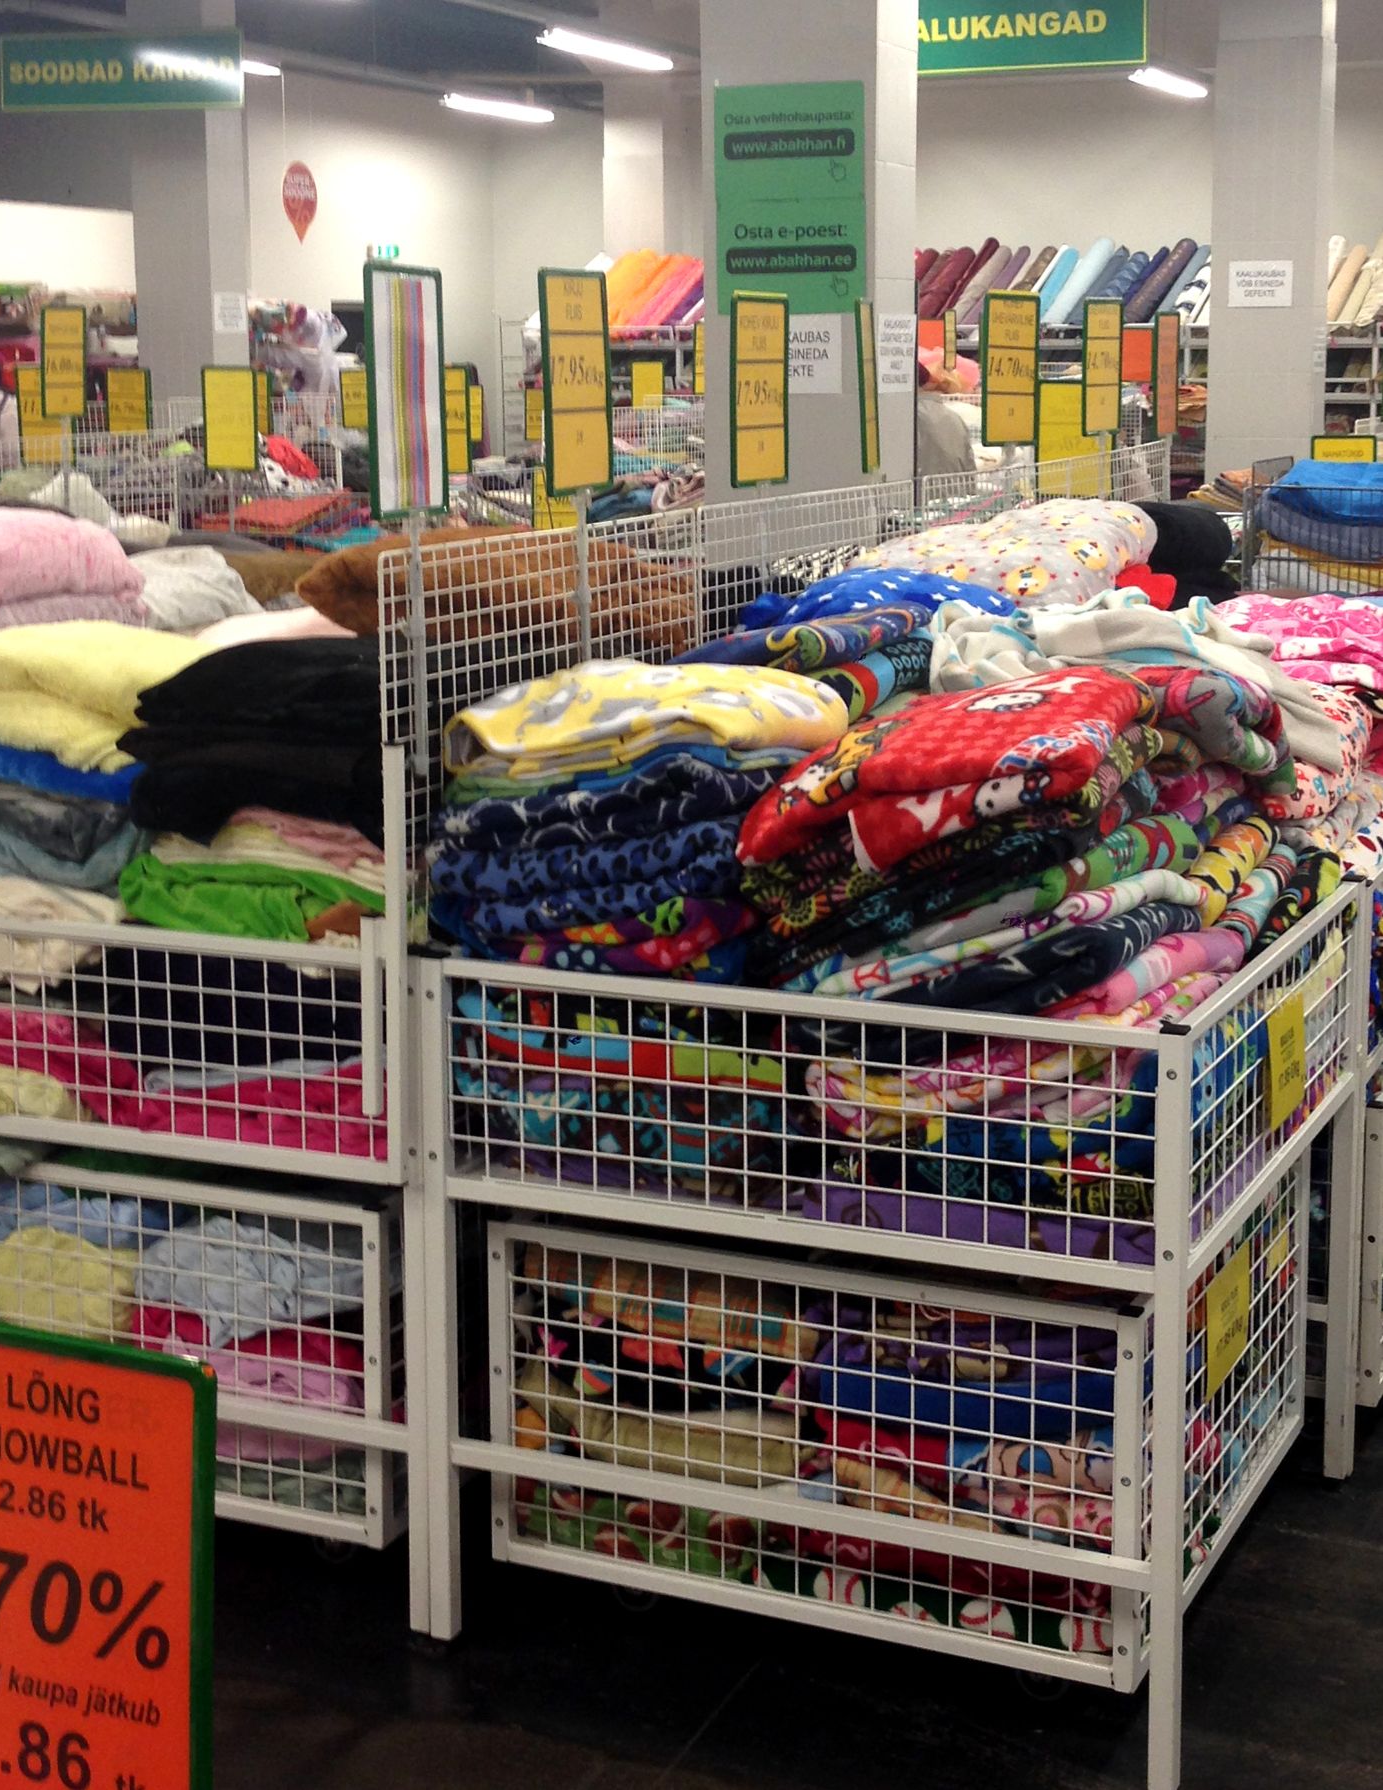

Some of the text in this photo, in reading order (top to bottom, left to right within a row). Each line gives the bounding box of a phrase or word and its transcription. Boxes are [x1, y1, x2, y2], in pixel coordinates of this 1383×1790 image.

[10, 59, 123, 84] SOODSAD
[724, 113, 751, 126] Osta
[731, 135, 846, 154] www.abakhan.fi
[734, 223, 848, 241] Osta e-poest:
[730, 252, 852, 268] www.abakhan.ee
[6, 1370, 101, 1425] LÕNG
[77, 1498, 109, 1533] tk
[7, 1667, 79, 1707] kaupa
[82, 1684, 162, 1728] jätkub
